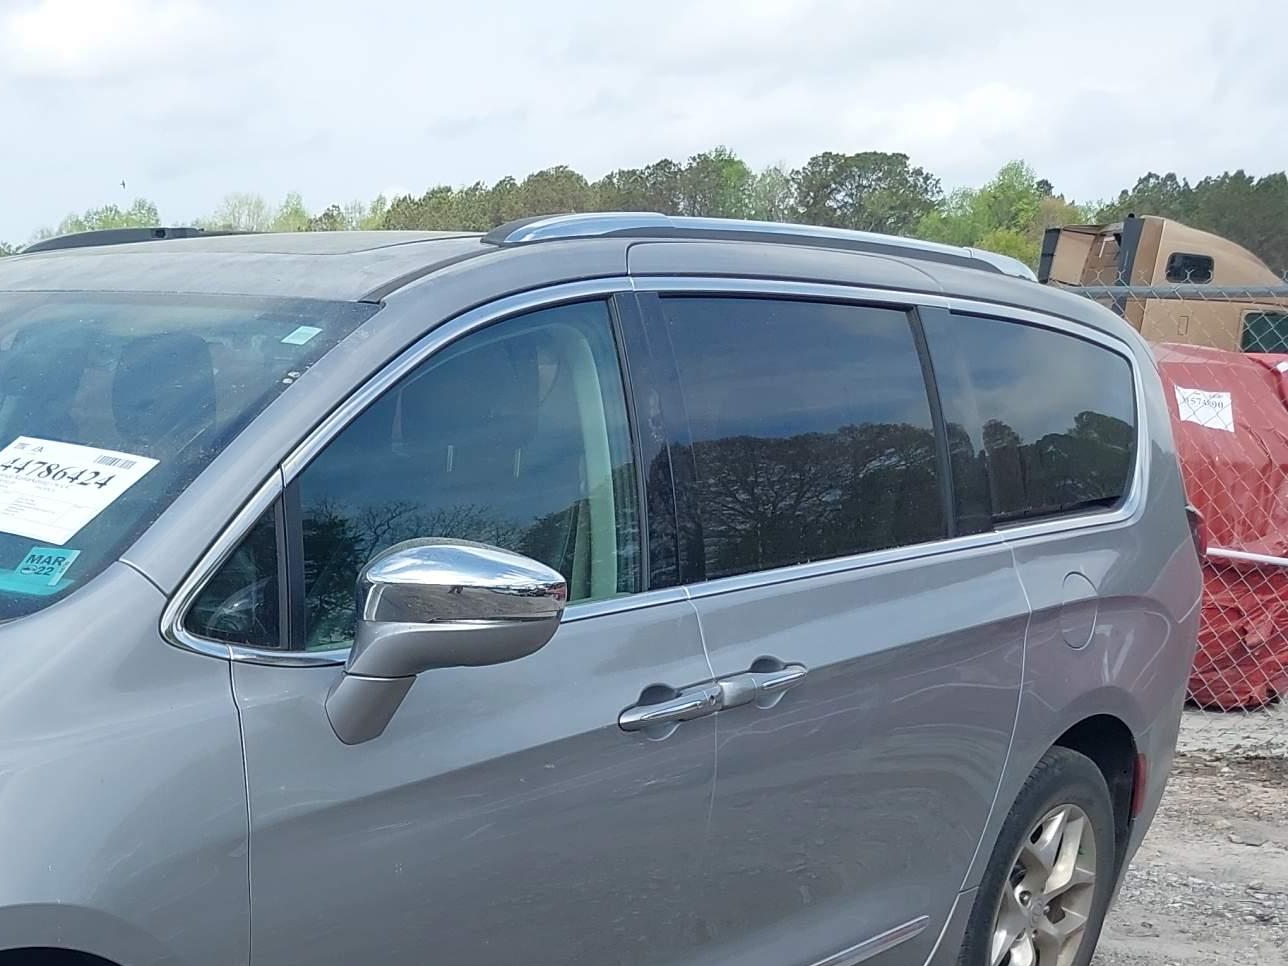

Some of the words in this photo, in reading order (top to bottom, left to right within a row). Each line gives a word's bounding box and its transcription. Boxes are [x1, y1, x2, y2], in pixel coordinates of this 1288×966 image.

[0, 457, 116, 489] 44786424
[25, 554, 66, 566] MAR
[34, 566, 56, 576] 22
